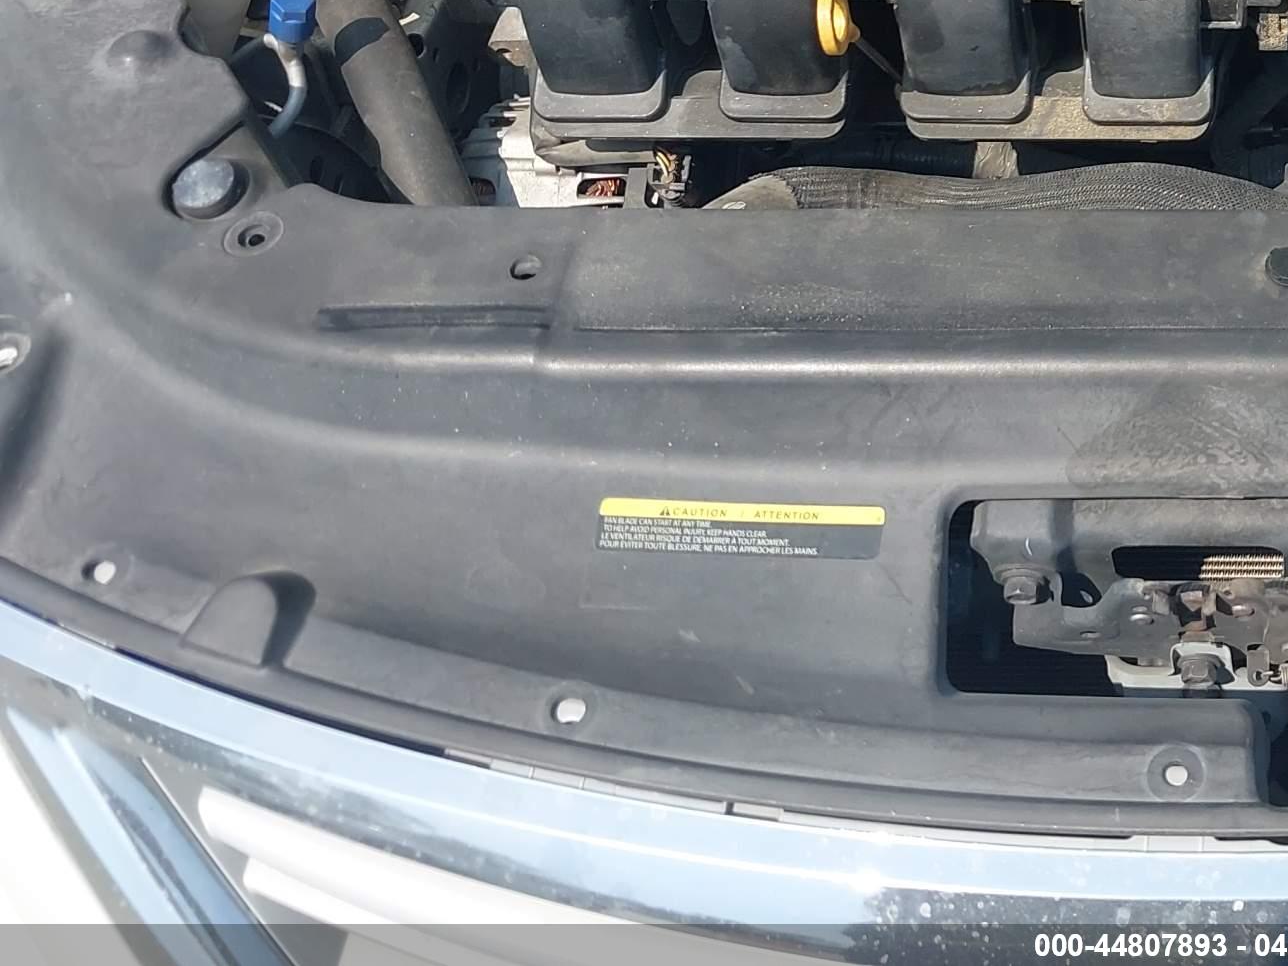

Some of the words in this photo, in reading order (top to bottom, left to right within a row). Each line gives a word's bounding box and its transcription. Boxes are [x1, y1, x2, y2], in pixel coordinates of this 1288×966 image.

[672, 508, 727, 518] CAUTION
[754, 510, 819, 520] ATTENTION
[639, 517, 652, 525] CAN
[654, 518, 672, 526] START
[613, 524, 629, 532] HELP
[631, 525, 649, 533] AVOID
[651, 525, 682, 534] PERSONAL
[723, 528, 745, 536] HANDS
[611, 532, 655, 541] VENTILATEUR
[656, 534, 680, 542] RISQUE
[682, 535, 691, 543] DE
[738, 537, 756, 545] TOUT
[600, 539, 619, 548] POUR
[644, 541, 666, 550] TOUTE
[704, 543, 712, 551] NE
[715, 544, 727, 552] PAS
[729, 544, 738, 552] EN
[739, 544, 781, 554] APPROCHER
[781, 546, 793, 554] LES
